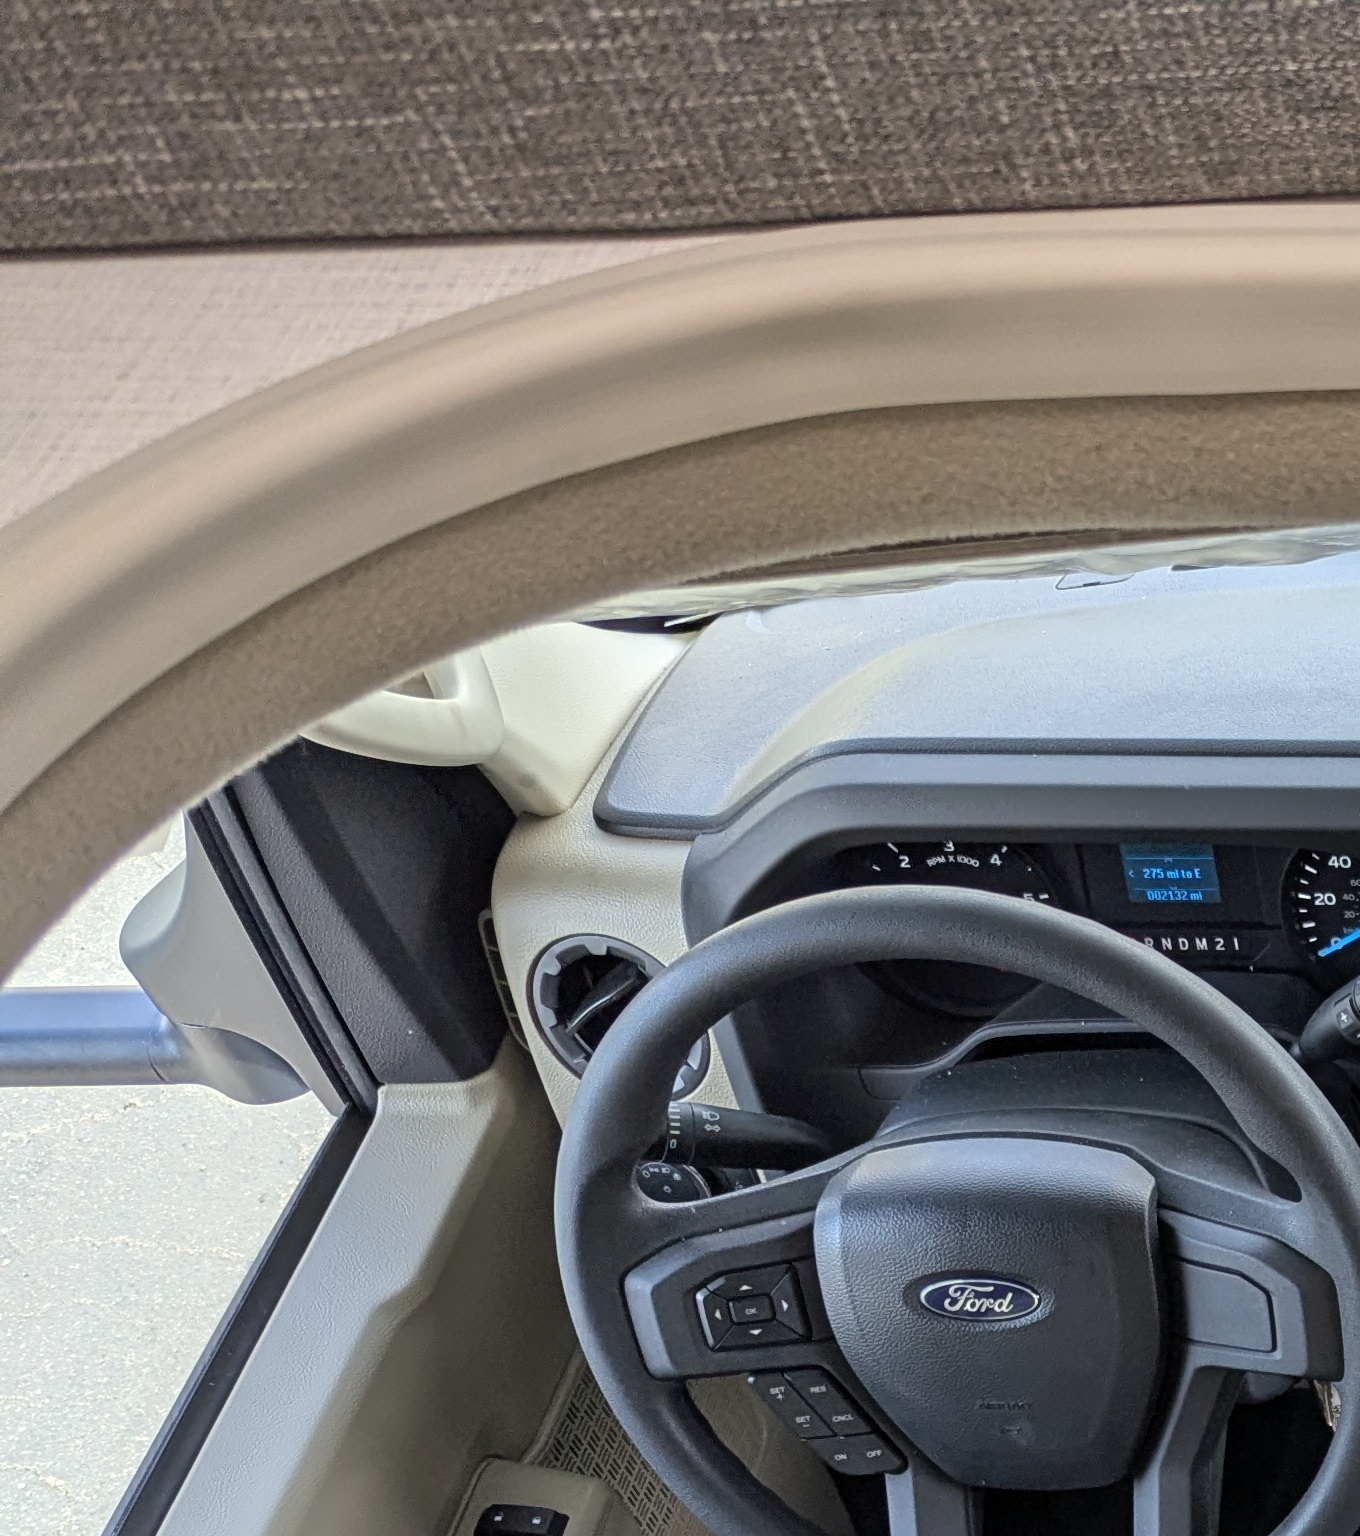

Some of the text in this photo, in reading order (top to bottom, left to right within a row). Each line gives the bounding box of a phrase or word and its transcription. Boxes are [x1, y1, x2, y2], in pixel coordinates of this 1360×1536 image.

[899, 856, 911, 868] 2
[926, 855, 946, 867] RPM
[990, 853, 1002, 866] 4
[1328, 855, 1351, 869] 40
[1143, 868, 1202, 879] 275 mi to E
[1147, 890, 1188, 901] 002132
[1313, 893, 1336, 906] 20
[1161, 937, 1173, 951] N
[1178, 937, 1189, 951] D
[1195, 937, 1208, 951] M
[1214, 937, 1226, 951] 2
[943, 1284, 1014, 1313] Ford
[770, 1386, 785, 1394] SET
[810, 1385, 827, 1393] RES
[795, 1415, 811, 1424] SET
[832, 1414, 855, 1423] CNCL
[834, 1453, 848, 1461] ON
[866, 1450, 883, 1458] OFF
